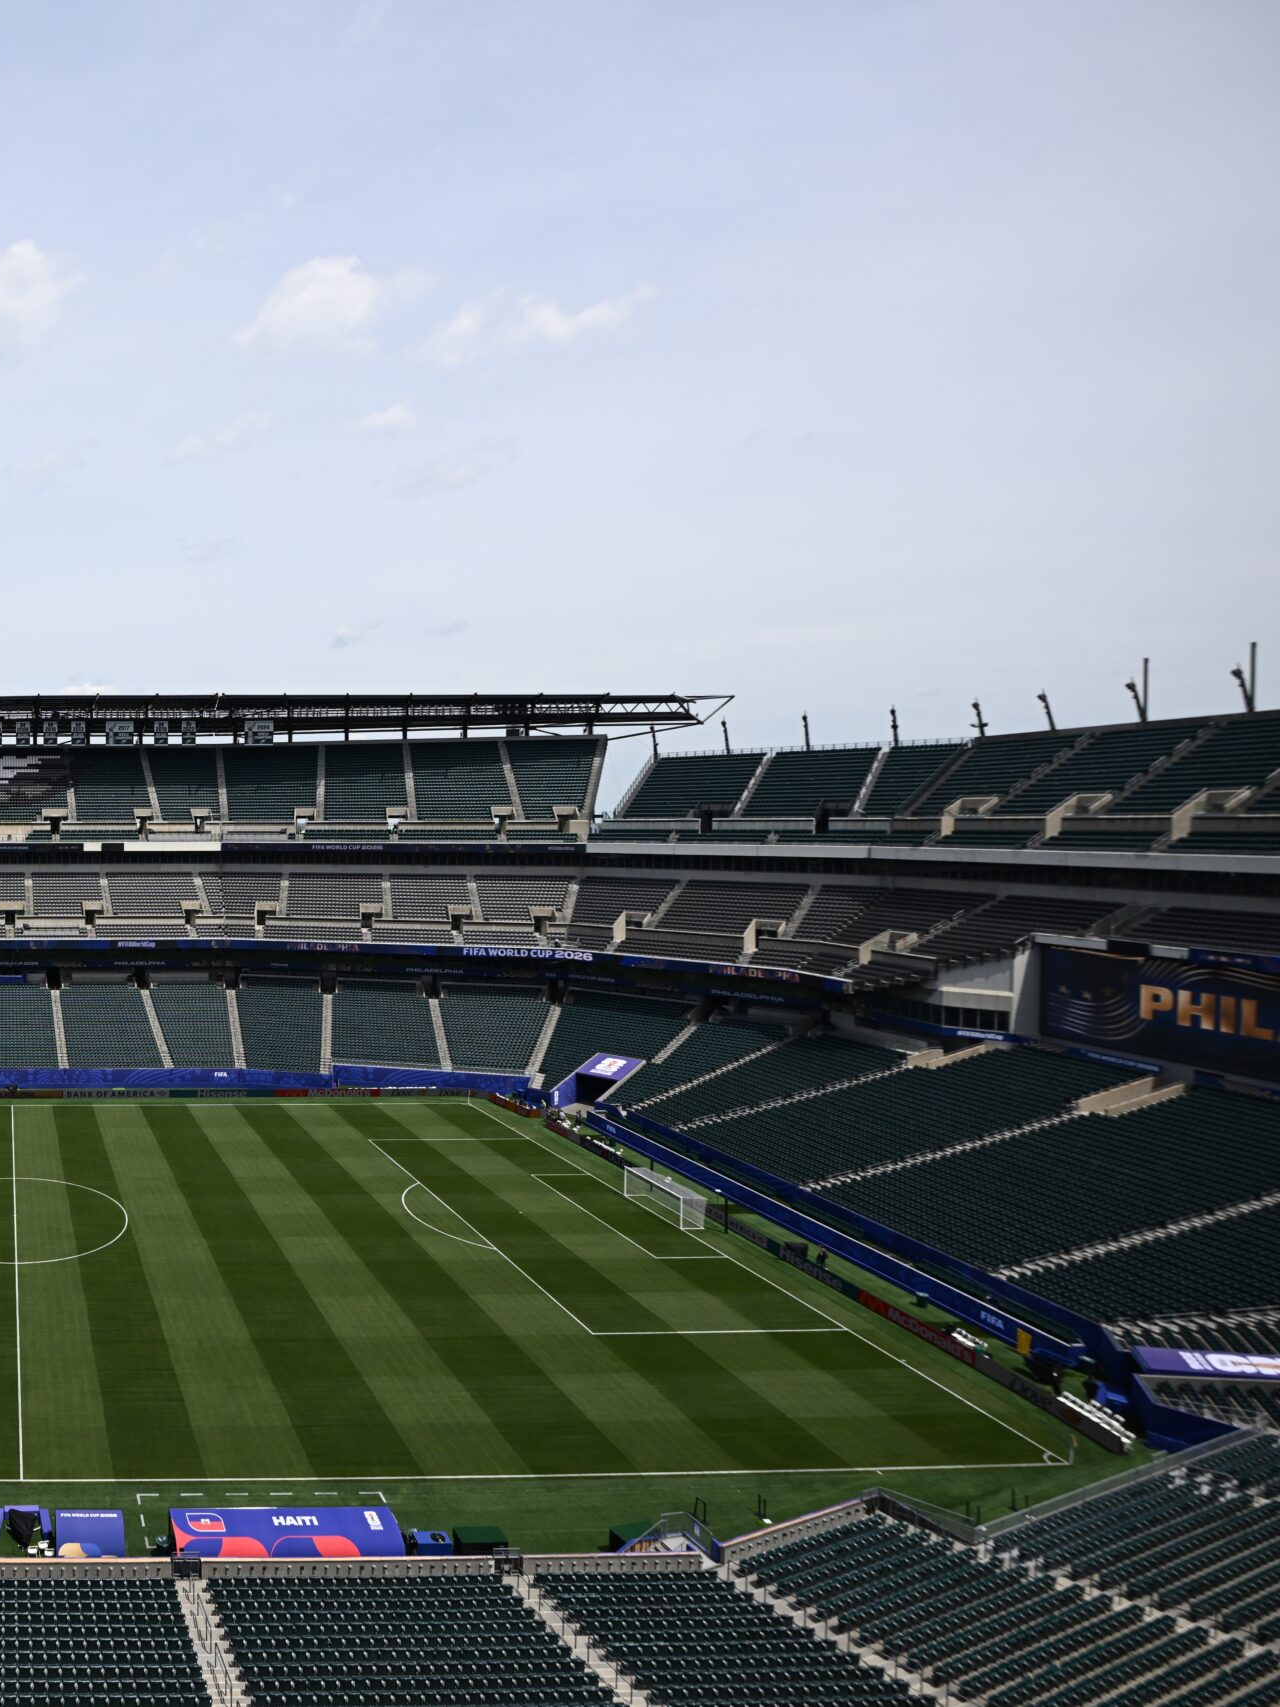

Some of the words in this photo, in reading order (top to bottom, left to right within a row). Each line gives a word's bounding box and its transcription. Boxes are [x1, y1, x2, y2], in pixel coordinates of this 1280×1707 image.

[463, 947, 486, 956] FIFA
[488, 948, 528, 958] WORLD
[530, 949, 553, 959] CUP
[554, 950, 593, 961] 2026
[711, 989, 784, 1002] PHILADELPHIA
[1139, 984, 1280, 1042] PHIL
[196, 1089, 247, 1097] Hisense
[308, 1088, 370, 1097] McDonald's
[606, 1124, 617, 1134] FIFA
[779, 1244, 843, 1290] Hisense
[979, 1311, 1005, 1331] FIFA
[887, 1307, 976, 1366] McDonald's
[271, 1515, 319, 1526] HAITI
